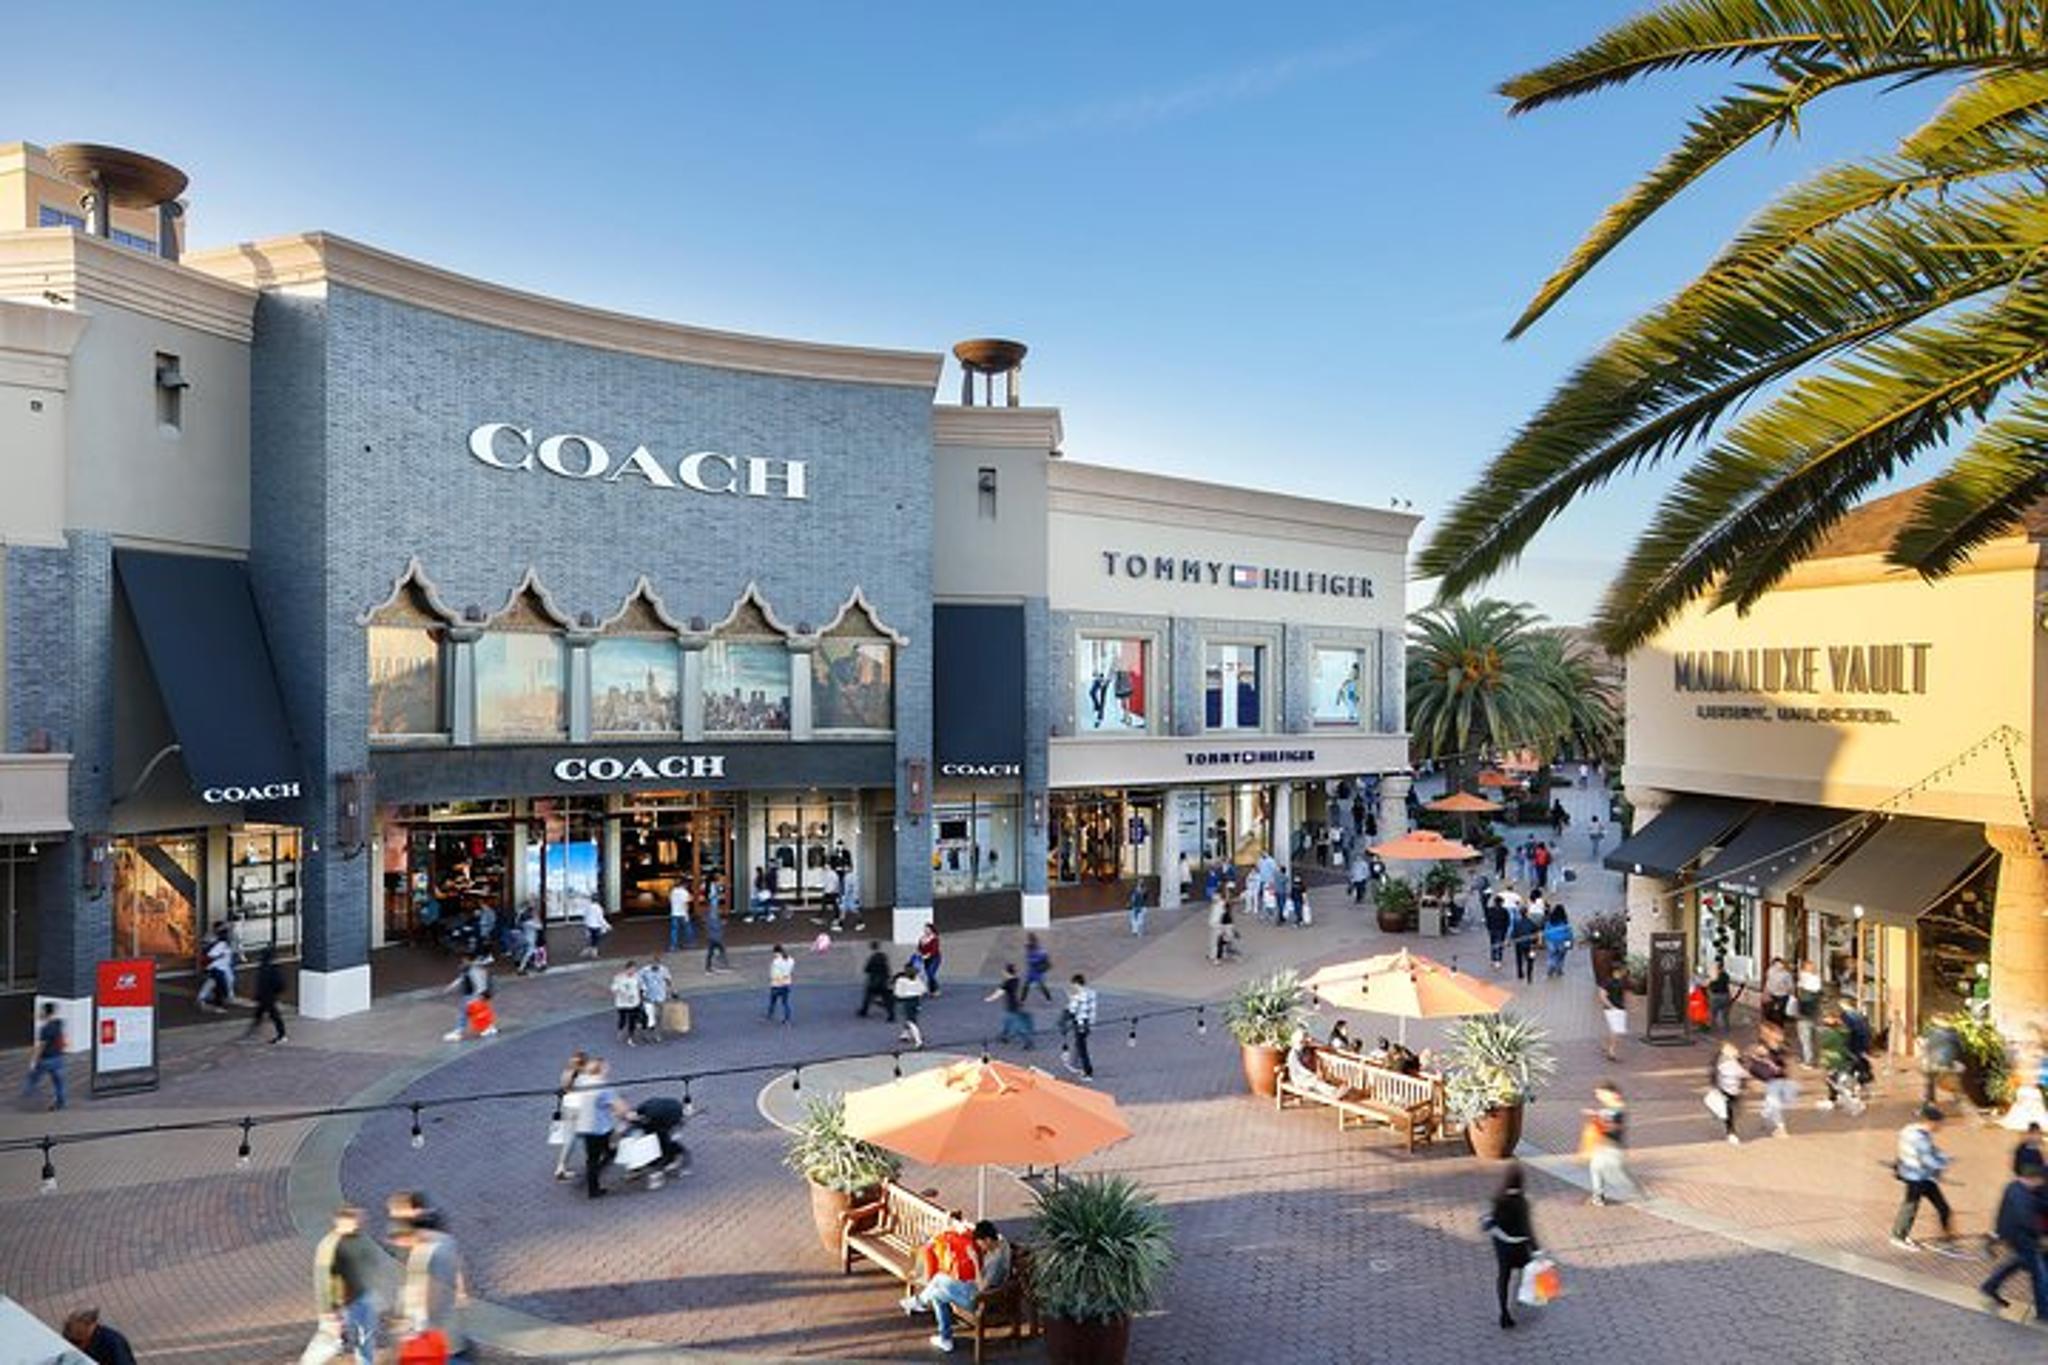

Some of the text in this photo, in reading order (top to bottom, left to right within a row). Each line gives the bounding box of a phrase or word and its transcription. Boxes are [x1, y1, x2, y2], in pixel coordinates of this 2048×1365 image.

[467, 422, 808, 499] COACH
[1102, 550, 1375, 598] TOMMY HILFIGER
[1674, 642, 1933, 695] MADALUXE VAULT
[553, 755, 727, 781] COACH
[941, 764, 1021, 777] COACH
[1185, 752, 1240, 766] TOMMY
[202, 782, 301, 804] COACH
